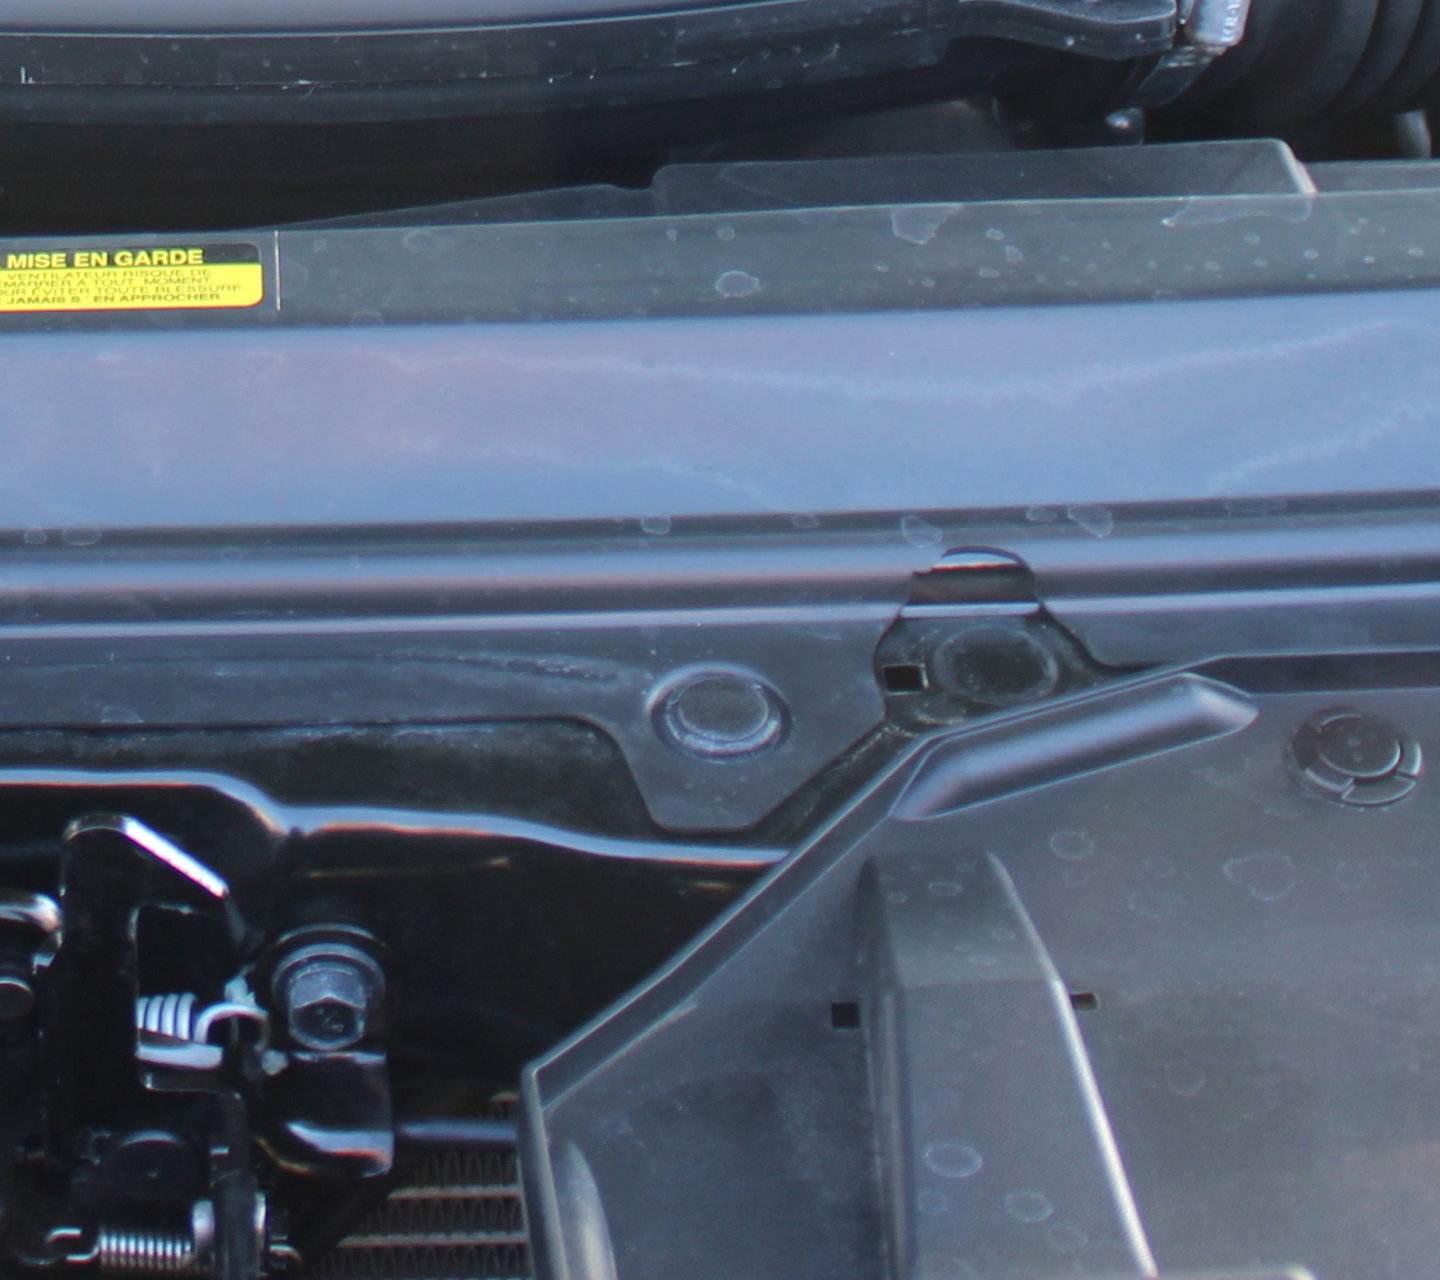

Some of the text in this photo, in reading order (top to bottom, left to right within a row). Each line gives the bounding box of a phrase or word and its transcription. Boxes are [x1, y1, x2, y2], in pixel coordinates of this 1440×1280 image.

[6, 249, 204, 269] MISE EN GARDE
[7, 271, 117, 281] VENTILATEUR
[123, 269, 184, 278] RISQUE
[190, 268, 211, 277] DE
[94, 278, 133, 287] TOUT
[144, 277, 209, 286] MOMENT
[97, 286, 149, 295] TOUTE
[6, 296, 65, 305] JAMAIS
[93, 295, 116, 303] EN
[119, 293, 221, 303] APPROCHER
